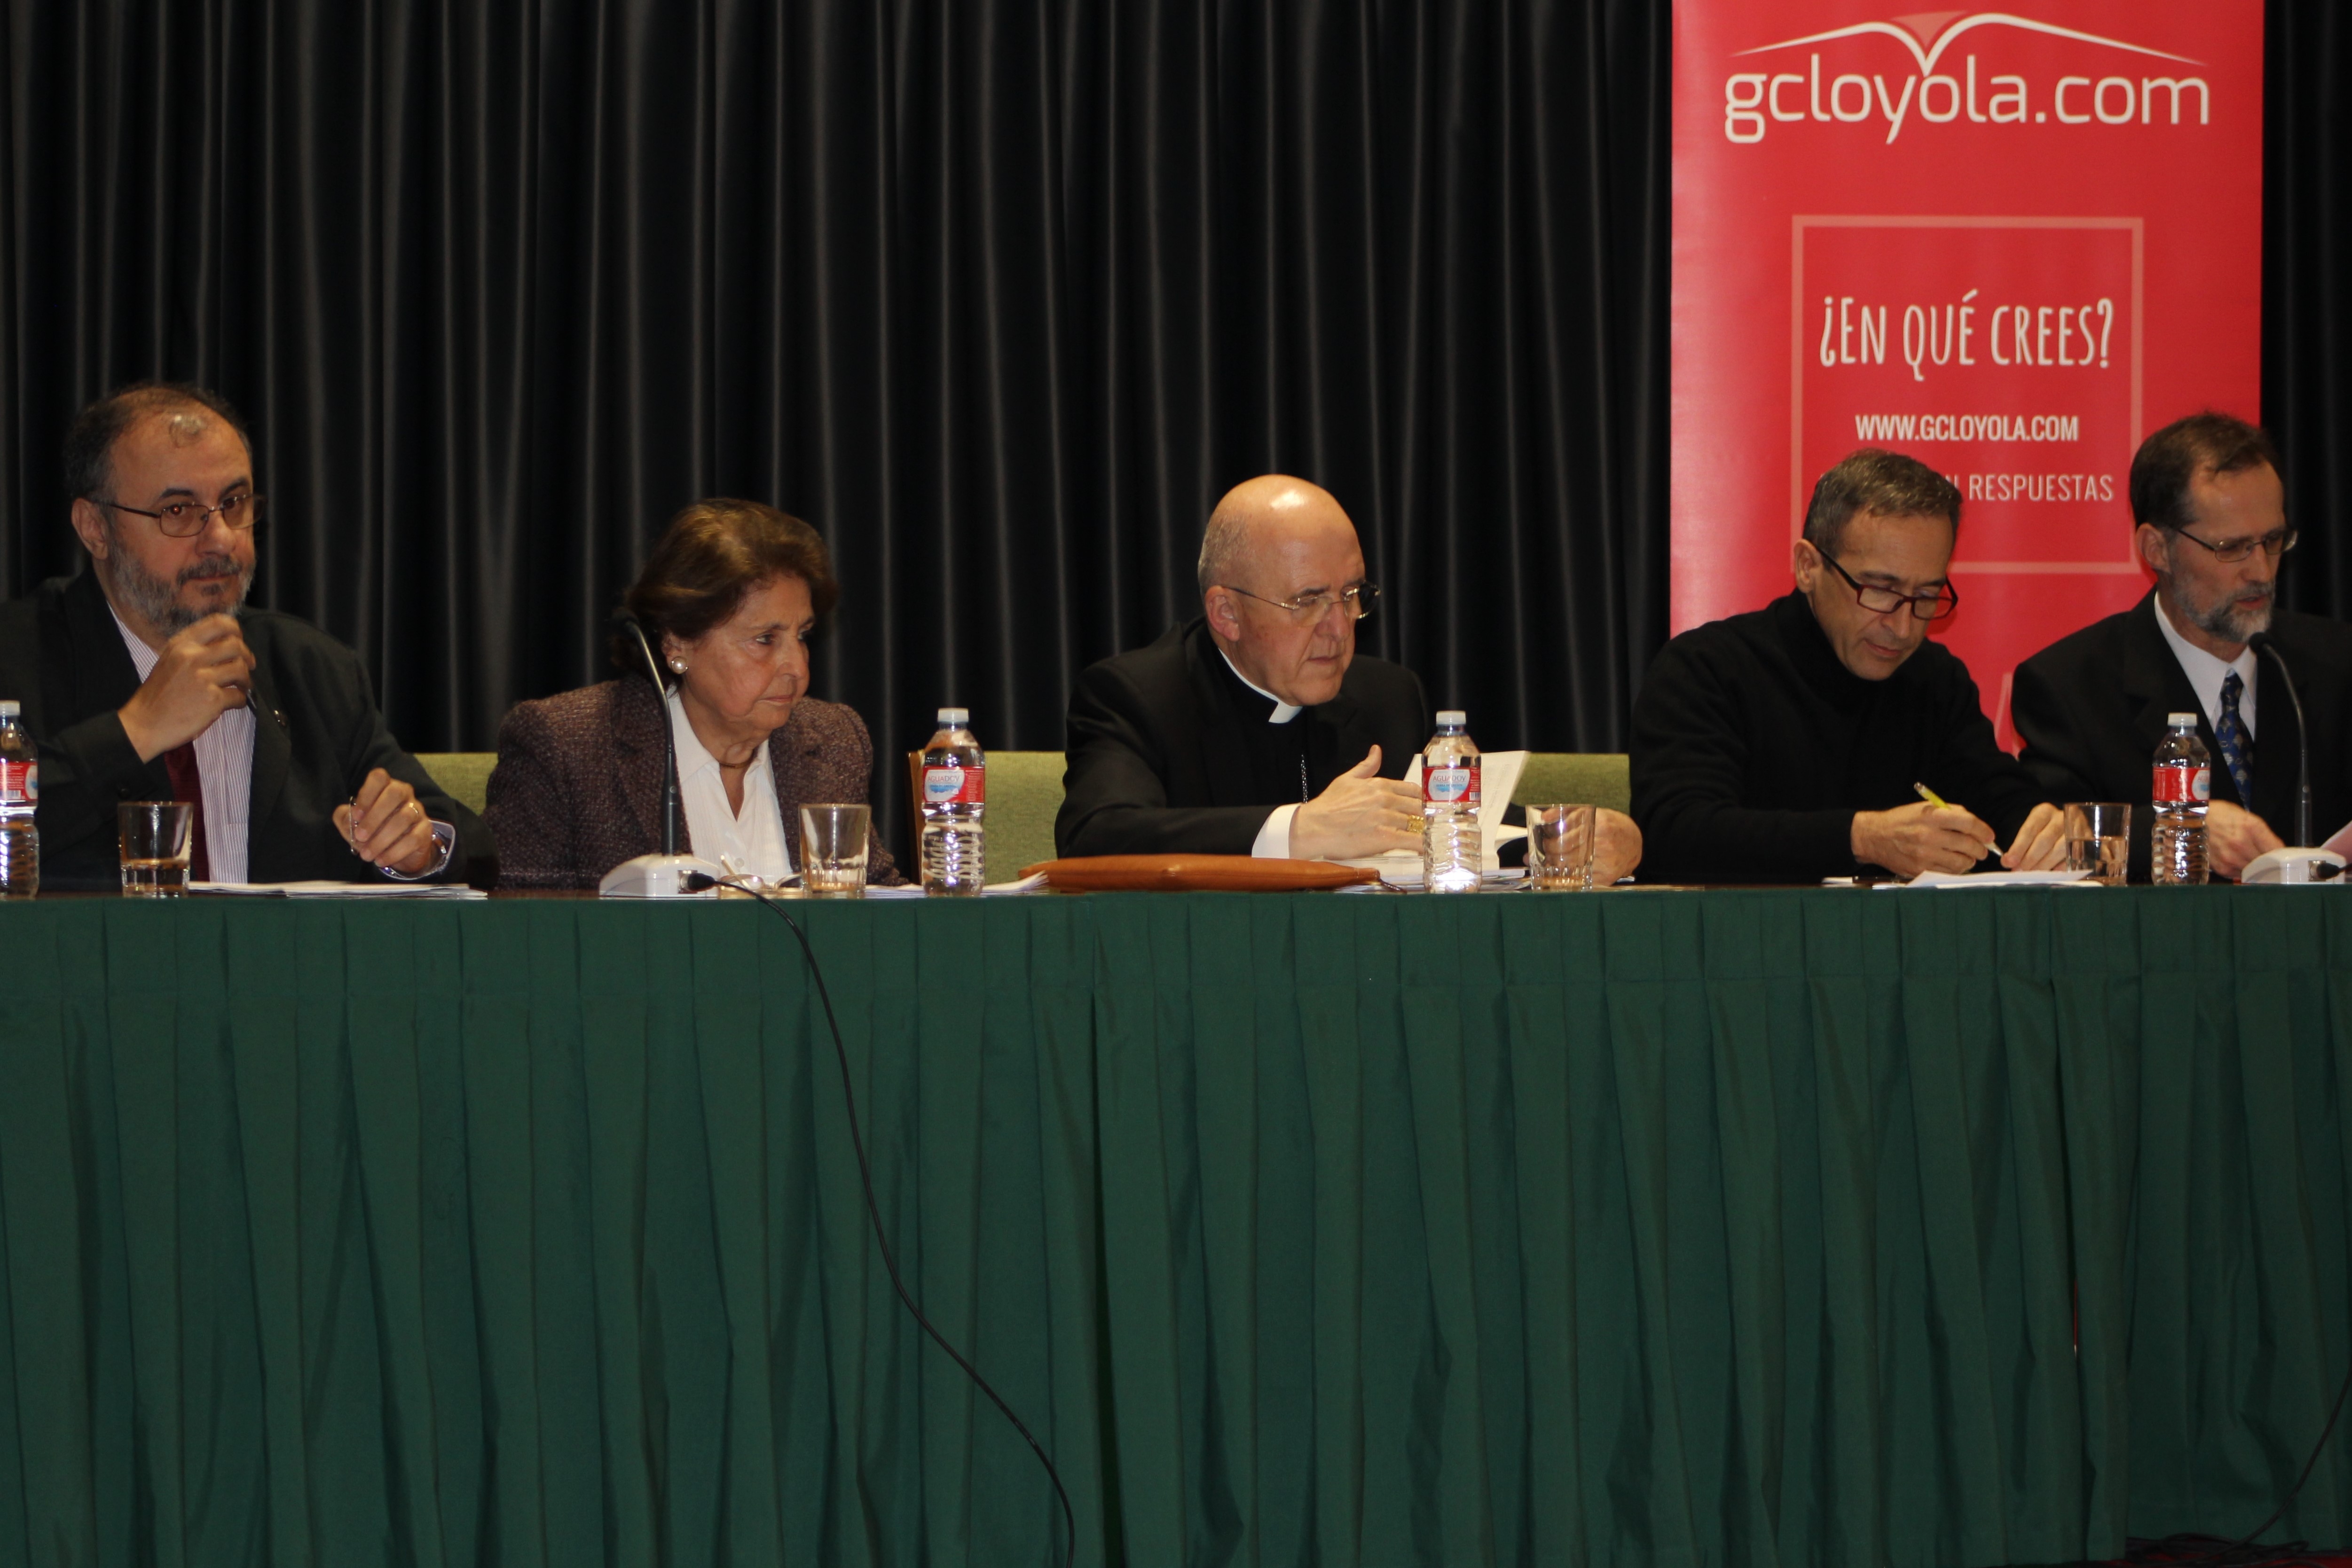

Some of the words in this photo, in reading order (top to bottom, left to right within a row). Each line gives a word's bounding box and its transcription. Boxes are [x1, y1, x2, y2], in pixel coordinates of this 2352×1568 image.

[1724, 53, 2209, 144] gcloyola.com
[1819, 296, 1887, 367] ¿EN
[1903, 289, 1978, 382] QUÉ
[1990, 298, 2114, 369] CREES?
[1855, 414, 2078, 441] WWW.GCLOYOLA.COM
[1969, 473, 2114, 501] RESPUESTAS
